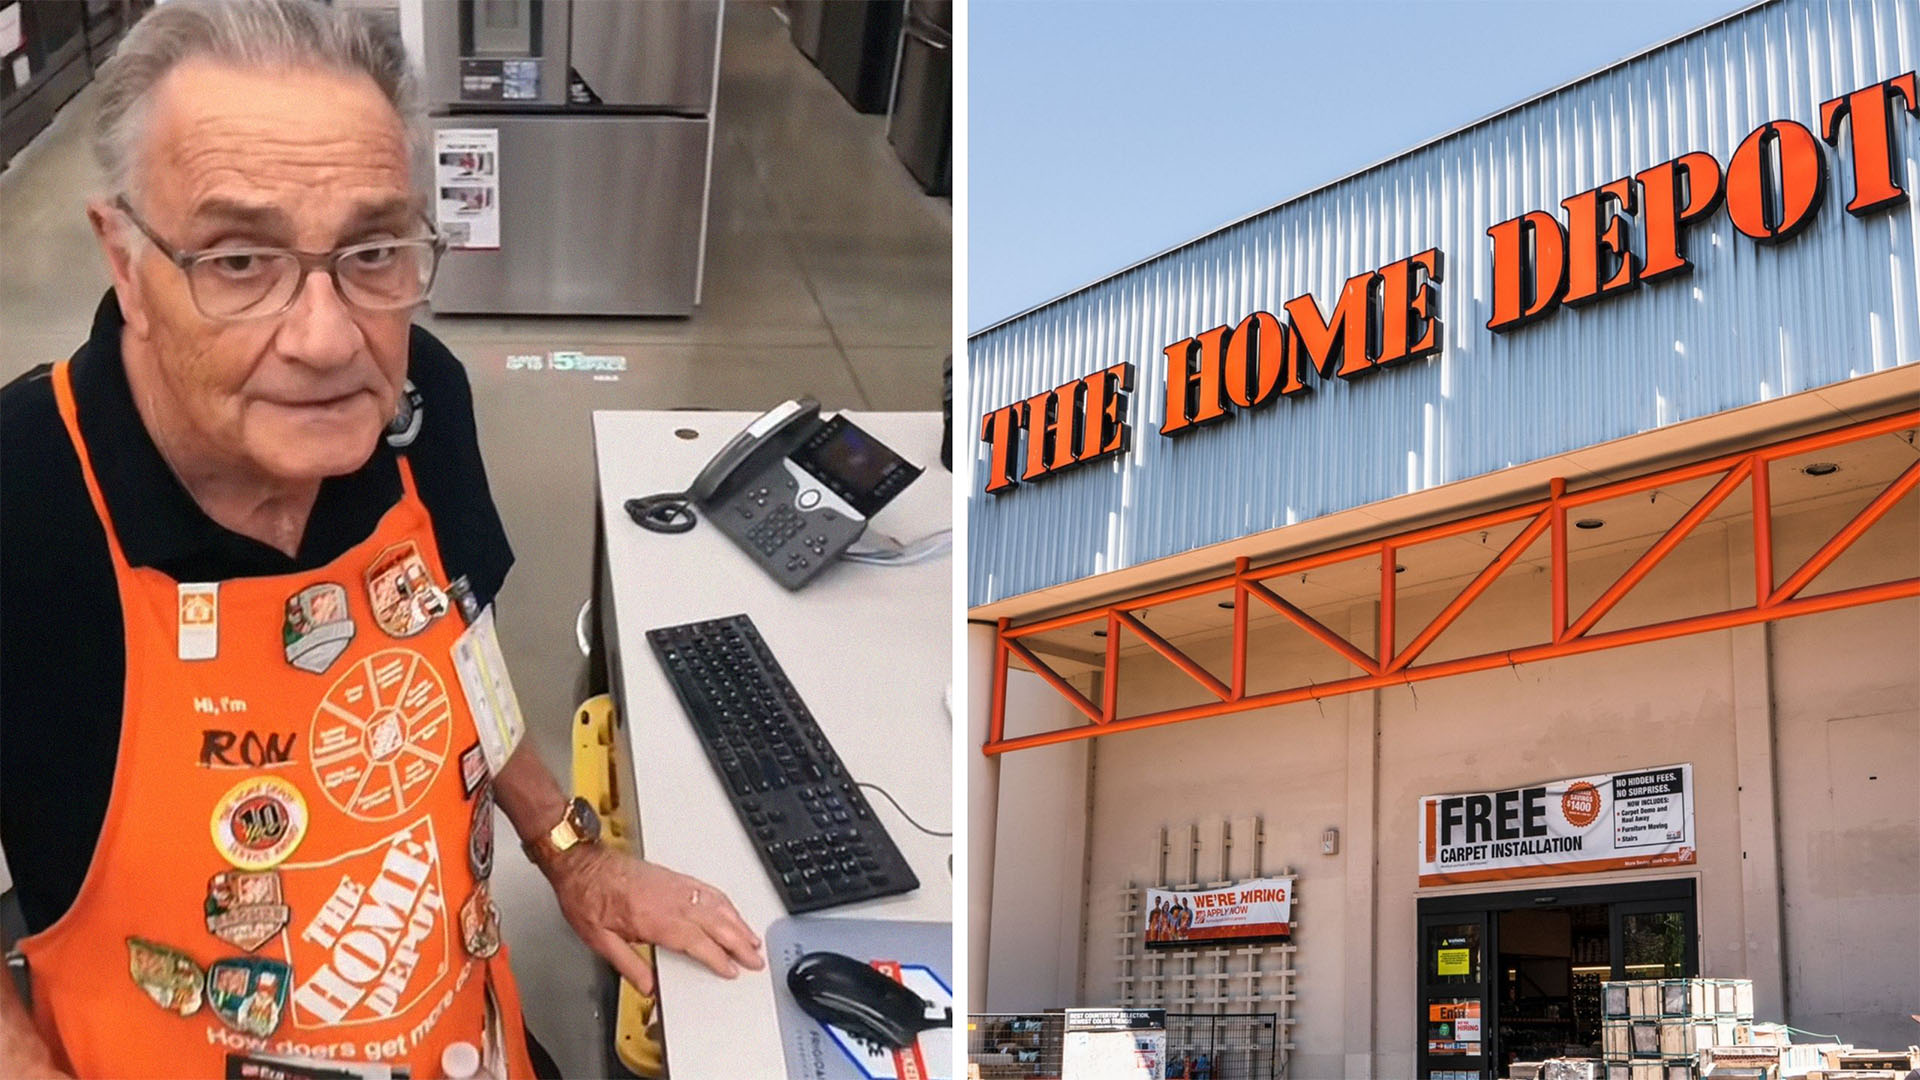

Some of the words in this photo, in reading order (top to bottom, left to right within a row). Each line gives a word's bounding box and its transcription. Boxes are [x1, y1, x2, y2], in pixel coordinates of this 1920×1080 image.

[981, 361, 1134, 495] THE
[1159, 247, 1444, 437] HOME
[1486, 70, 1920, 334] DEPOT
[193, 697, 219, 715] Hi,
[220, 697, 247, 712] I'm
[200, 729, 297, 768] RON
[1616, 779, 1626, 787] NO
[1628, 776, 1654, 786] HIDDEN
[1656, 773, 1677, 781] FEES.
[1616, 789, 1626, 798] NO
[1628, 784, 1671, 796] SURPRISES.
[1566, 800, 1592, 812] $1400
[1570, 794, 1593, 802] SAVINGS
[1641, 797, 1670, 805] INCLUDES:
[240, 803, 282, 837] 10
[1441, 787, 1548, 846] FREE
[1621, 808, 1639, 816] Carpet
[1440, 845, 1488, 863] CARPET
[1491, 835, 1583, 859] INSTALLATION
[1193, 892, 1237, 908] WE'RE
[1240, 888, 1286, 904] HIRING
[302, 875, 366, 950] THE
[1207, 908, 1230, 918] APPLY
[1230, 905, 1249, 915] NOW
[294, 829, 437, 1025] HOME
[363, 883, 441, 1018] DEPOT
[206, 1026, 267, 1051] How
[275, 1040, 356, 1058] doers
[364, 1034, 407, 1061] get
[411, 989, 454, 1047] more
